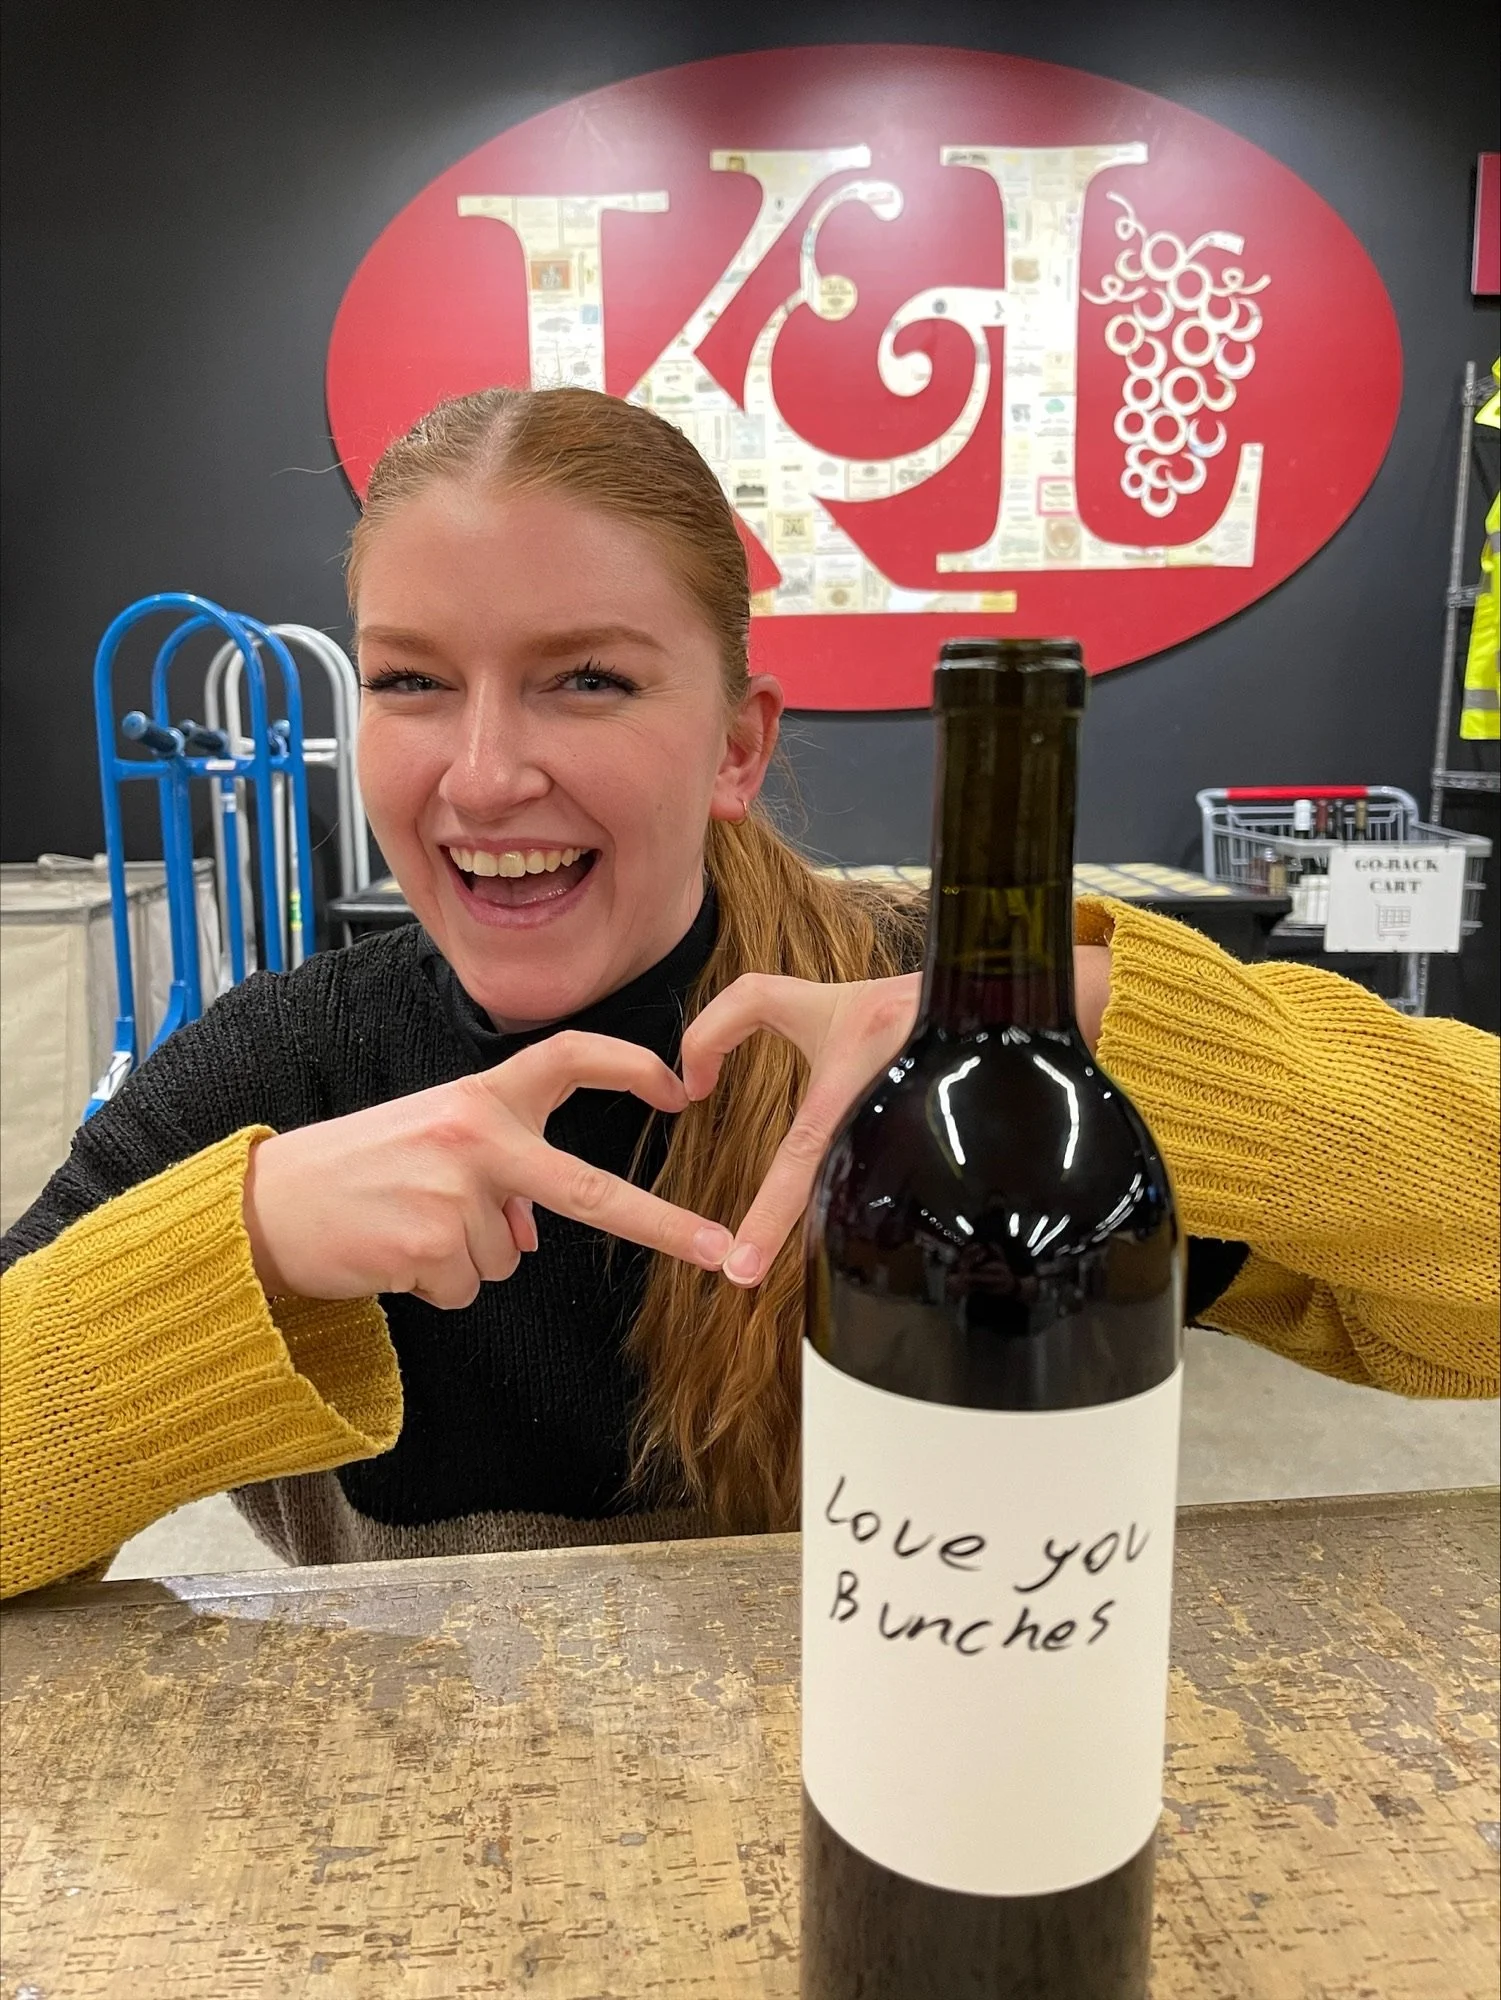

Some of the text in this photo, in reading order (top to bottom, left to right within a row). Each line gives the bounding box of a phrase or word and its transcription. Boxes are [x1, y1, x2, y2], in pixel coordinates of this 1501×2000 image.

[457, 142, 1264, 614] K&L
[1354, 858, 1440, 873] GO-BACK
[1368, 879, 1422, 894] CART
